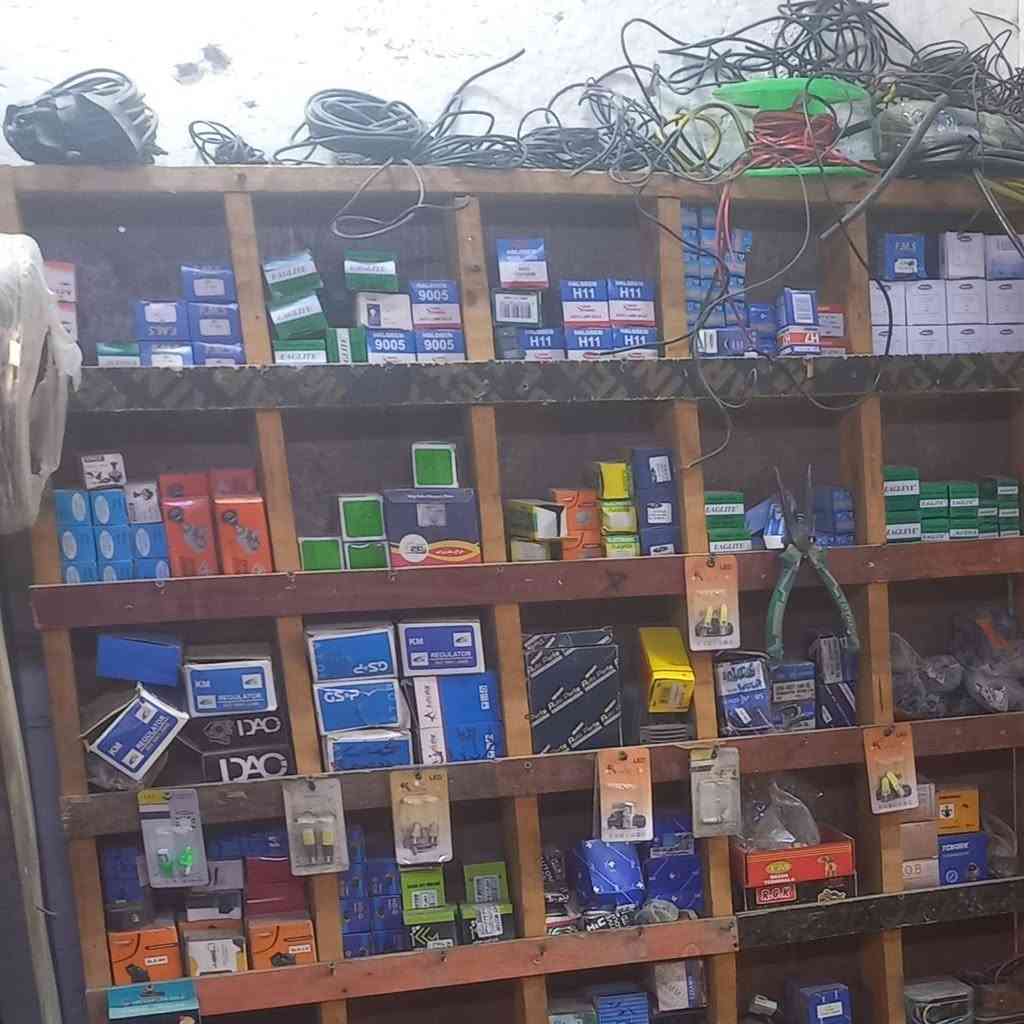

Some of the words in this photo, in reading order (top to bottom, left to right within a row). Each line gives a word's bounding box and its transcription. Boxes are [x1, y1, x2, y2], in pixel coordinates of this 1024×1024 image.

[418, 290, 448, 301] 9005
[573, 288, 595, 299] H11
[619, 287, 641, 298] H11
[375, 340, 406, 351] 9005
[424, 340, 454, 351] 9005
[530, 336, 551, 347] H11
[578, 336, 600, 347] H11
[624, 335, 646, 346] H11
[136, 715, 169, 752] REGULATOR
